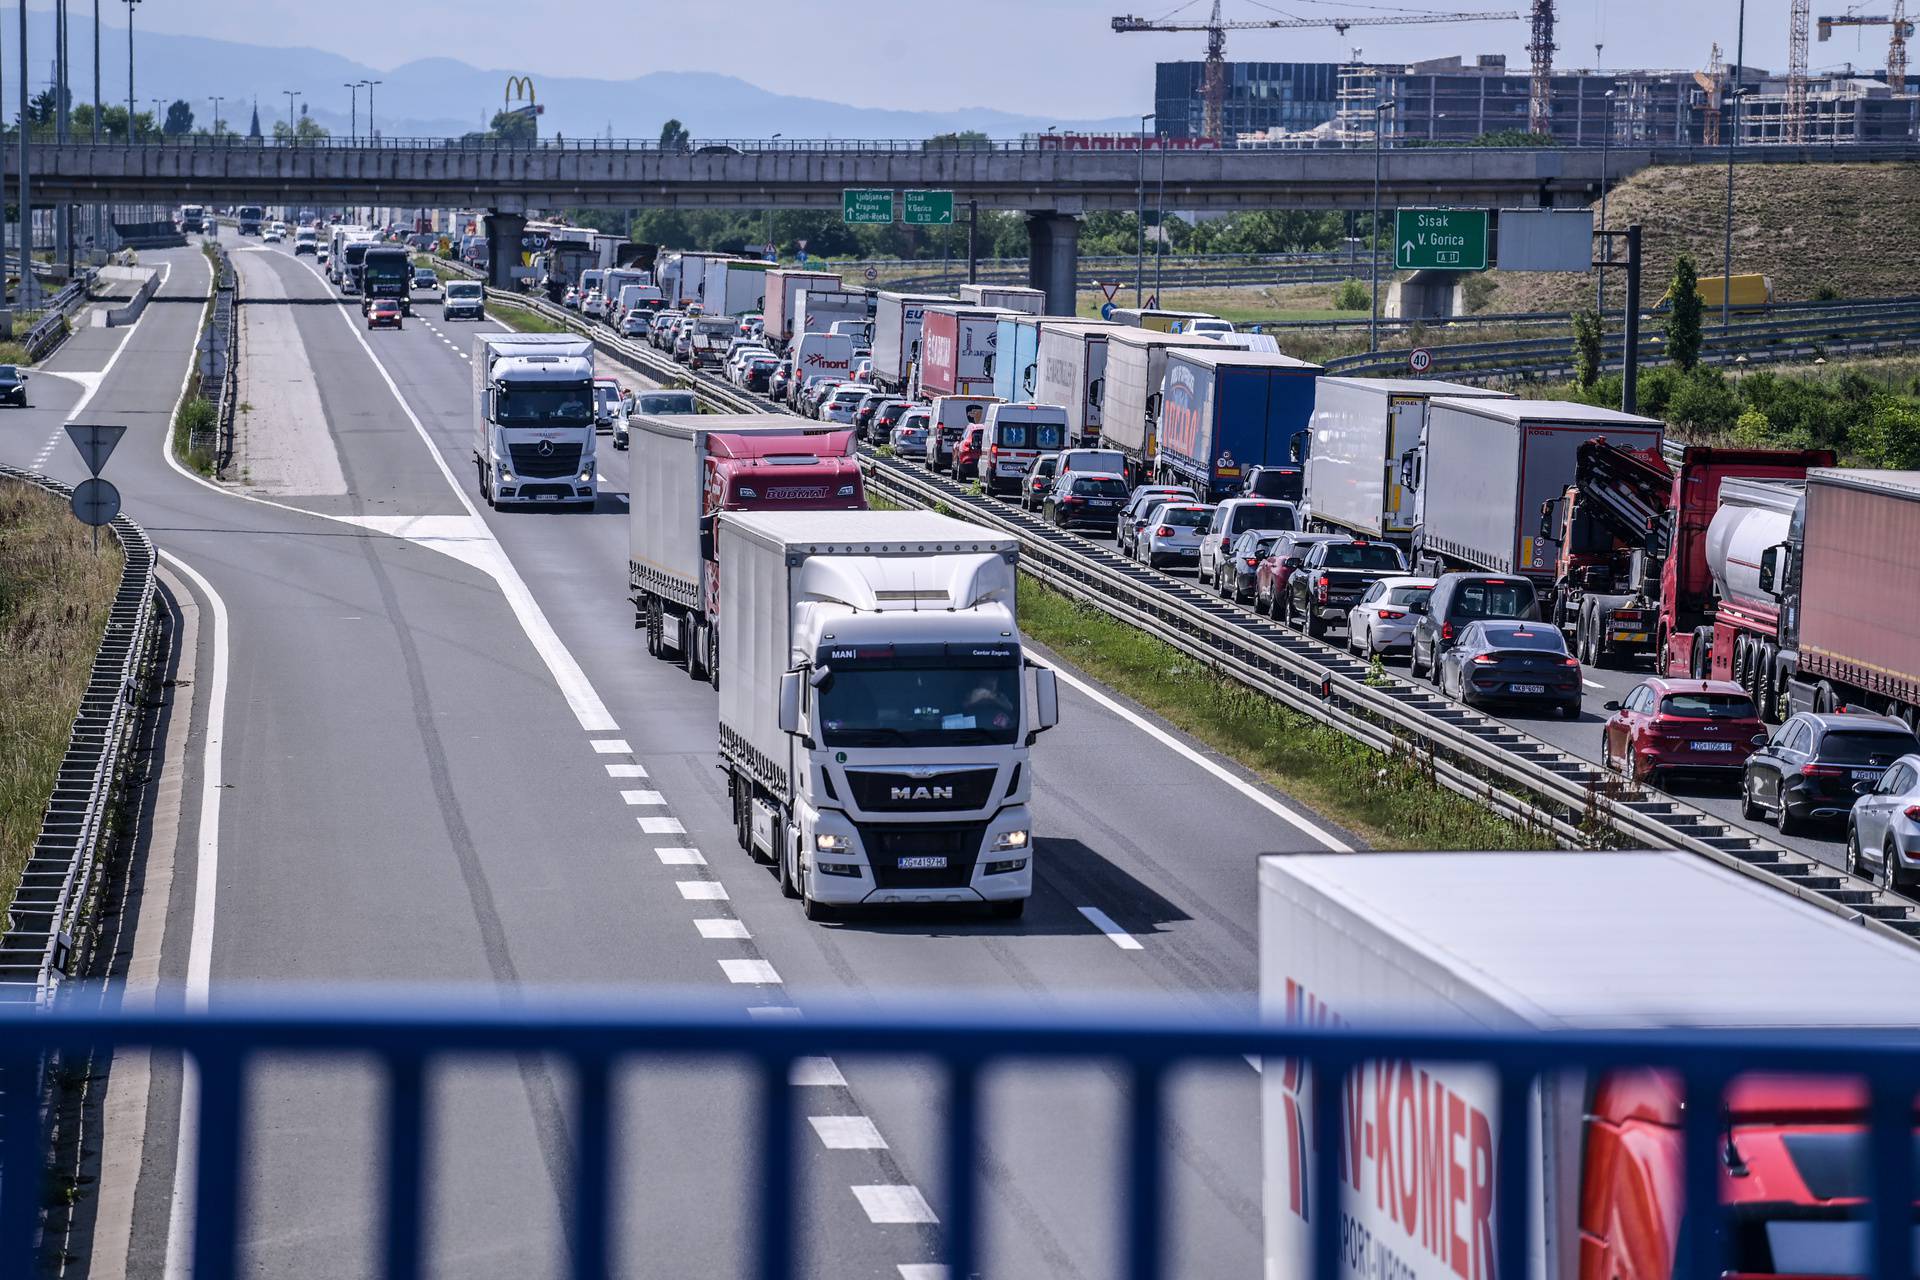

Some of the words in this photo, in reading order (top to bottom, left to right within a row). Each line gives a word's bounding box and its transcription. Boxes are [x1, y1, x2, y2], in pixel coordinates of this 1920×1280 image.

[1418, 215, 1449, 227] Sisak
[1430, 233, 1465, 246] Gorica
[1414, 354, 1427, 367] 40
[766, 486, 829, 499] BUDMAT
[832, 650, 852, 659] MAN
[891, 786, 953, 799] MAN
